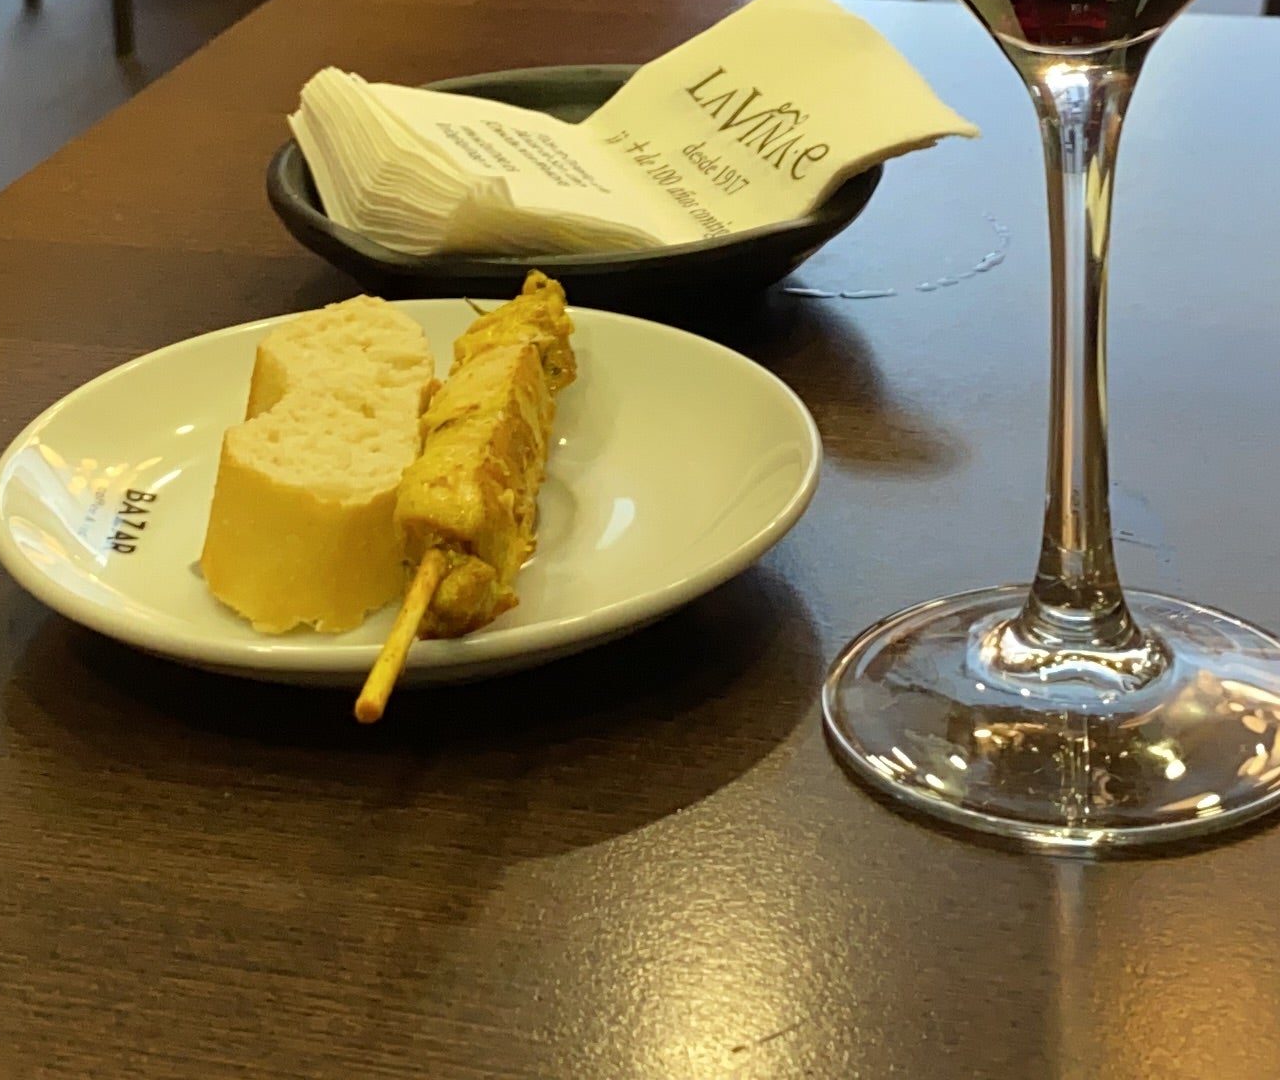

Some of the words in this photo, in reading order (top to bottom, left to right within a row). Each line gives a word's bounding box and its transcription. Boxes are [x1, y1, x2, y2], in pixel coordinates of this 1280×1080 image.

[634, 152, 662, 167] de
[682, 141, 722, 176] desde
[712, 164, 751, 196] 1917
[646, 164, 683, 186] 100
[666, 187, 700, 208] años
[689, 208, 733, 239] contig
[105, 488, 158, 554] BAZAR
